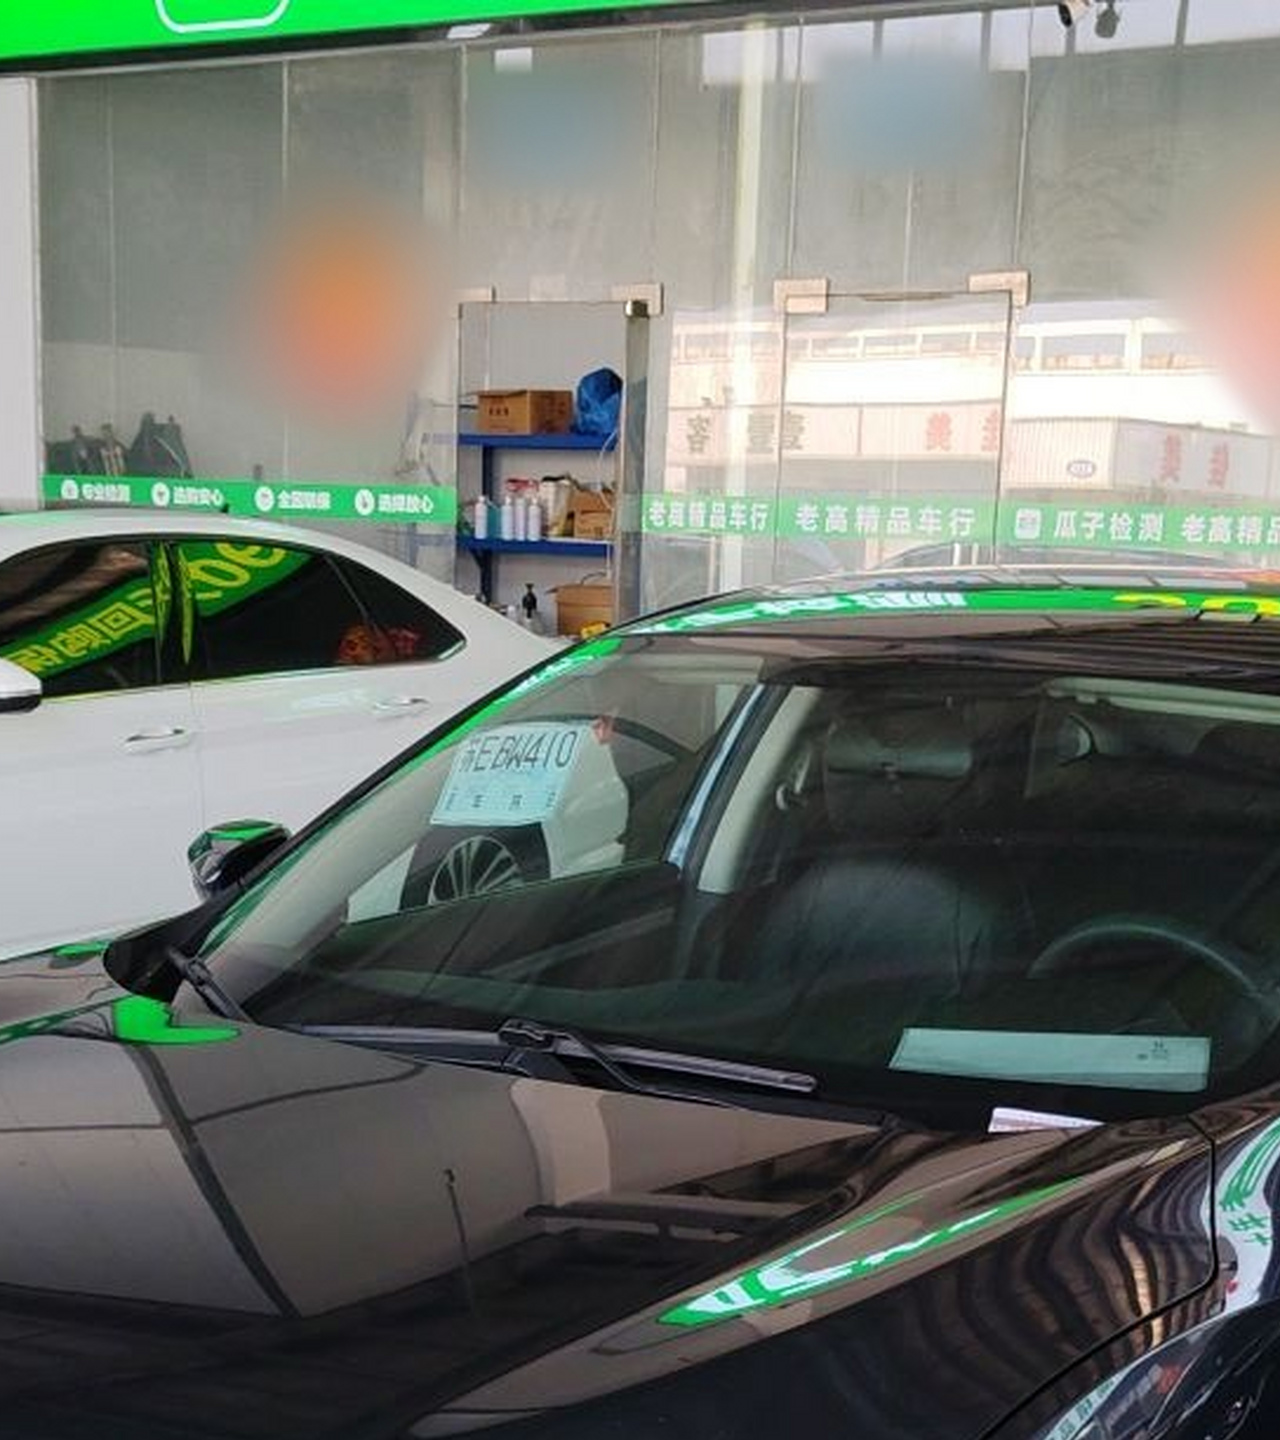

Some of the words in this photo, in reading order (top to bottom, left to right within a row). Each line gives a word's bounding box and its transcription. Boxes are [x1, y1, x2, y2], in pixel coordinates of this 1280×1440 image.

[796, 504, 976, 536] 老高精品车行
[1053, 511, 1164, 543] 瓜子检测
